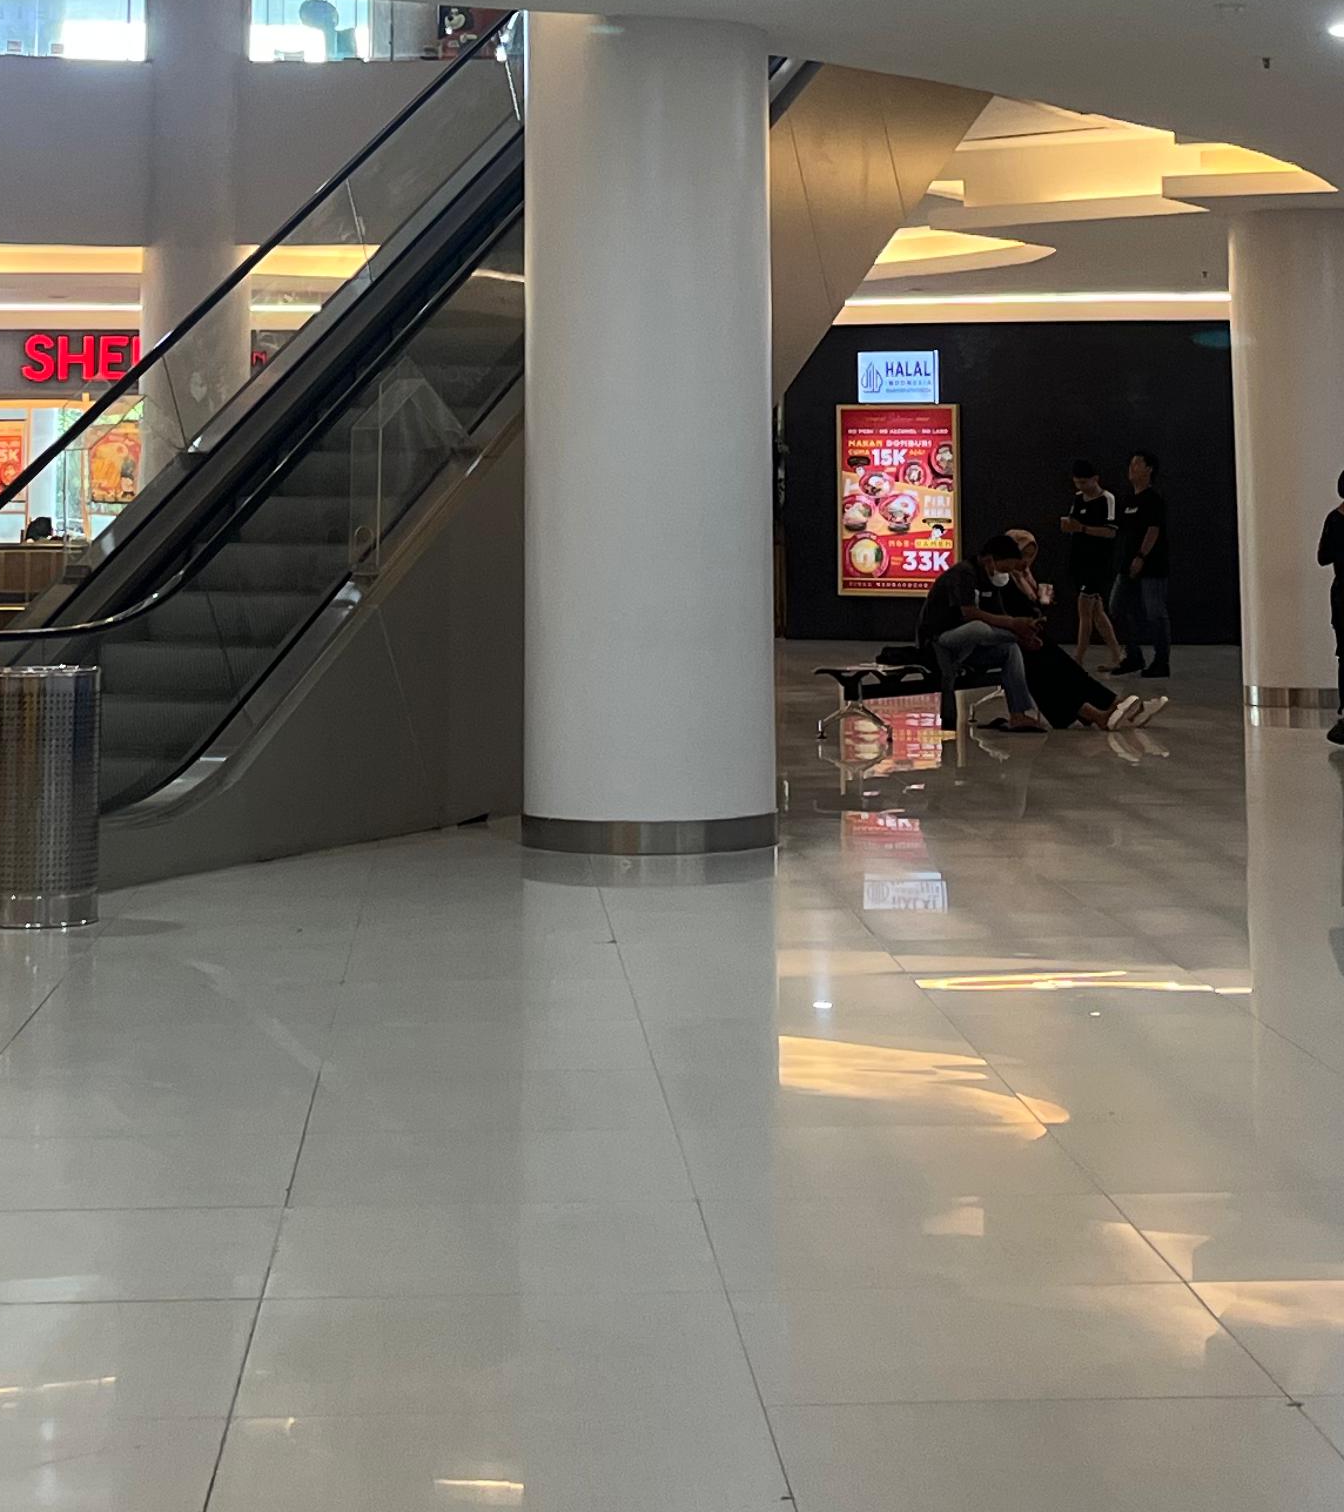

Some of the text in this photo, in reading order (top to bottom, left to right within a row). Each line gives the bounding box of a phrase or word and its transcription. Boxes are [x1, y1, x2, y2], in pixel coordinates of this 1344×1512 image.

[21, 334, 141, 382] SHE
[885, 360, 932, 378] HALAL
[871, 448, 908, 466] 15K
[902, 550, 951, 571] 33K
